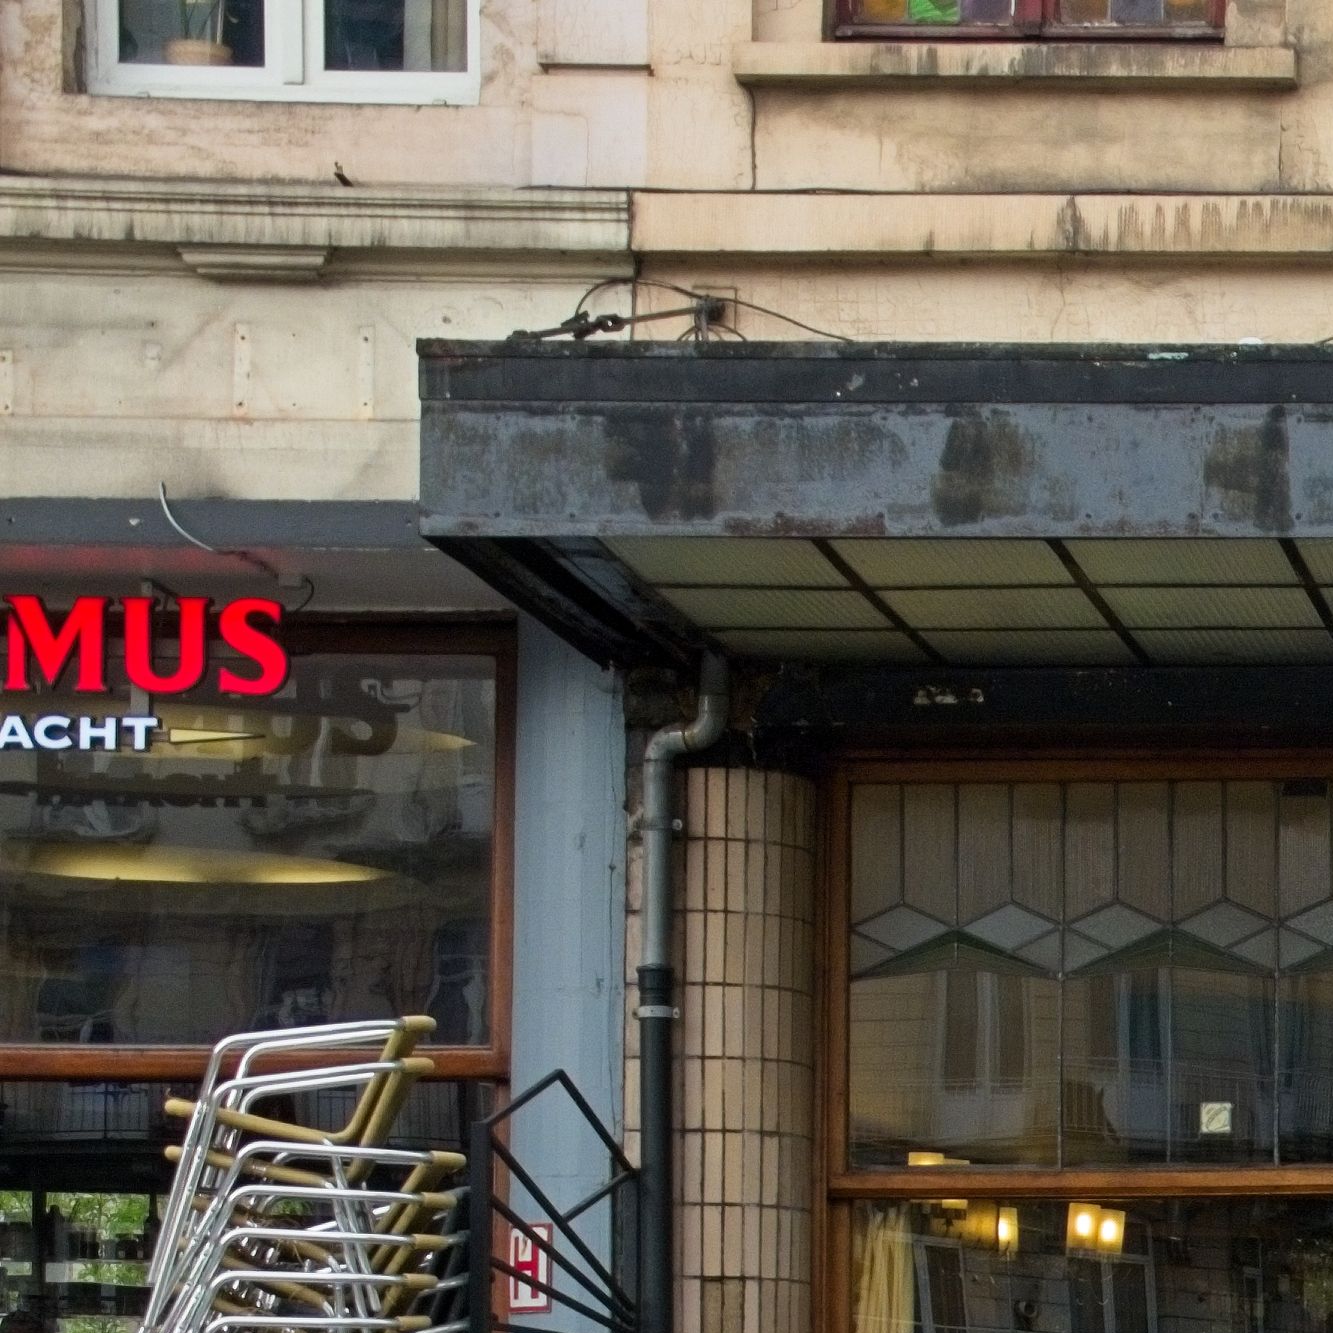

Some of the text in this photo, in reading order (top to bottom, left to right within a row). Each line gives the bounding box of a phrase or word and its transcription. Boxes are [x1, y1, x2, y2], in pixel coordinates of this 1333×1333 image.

[4, 594, 289, 697] MUS
[0, 714, 159, 751] ACHT
[513, 1235, 540, 1300] H
